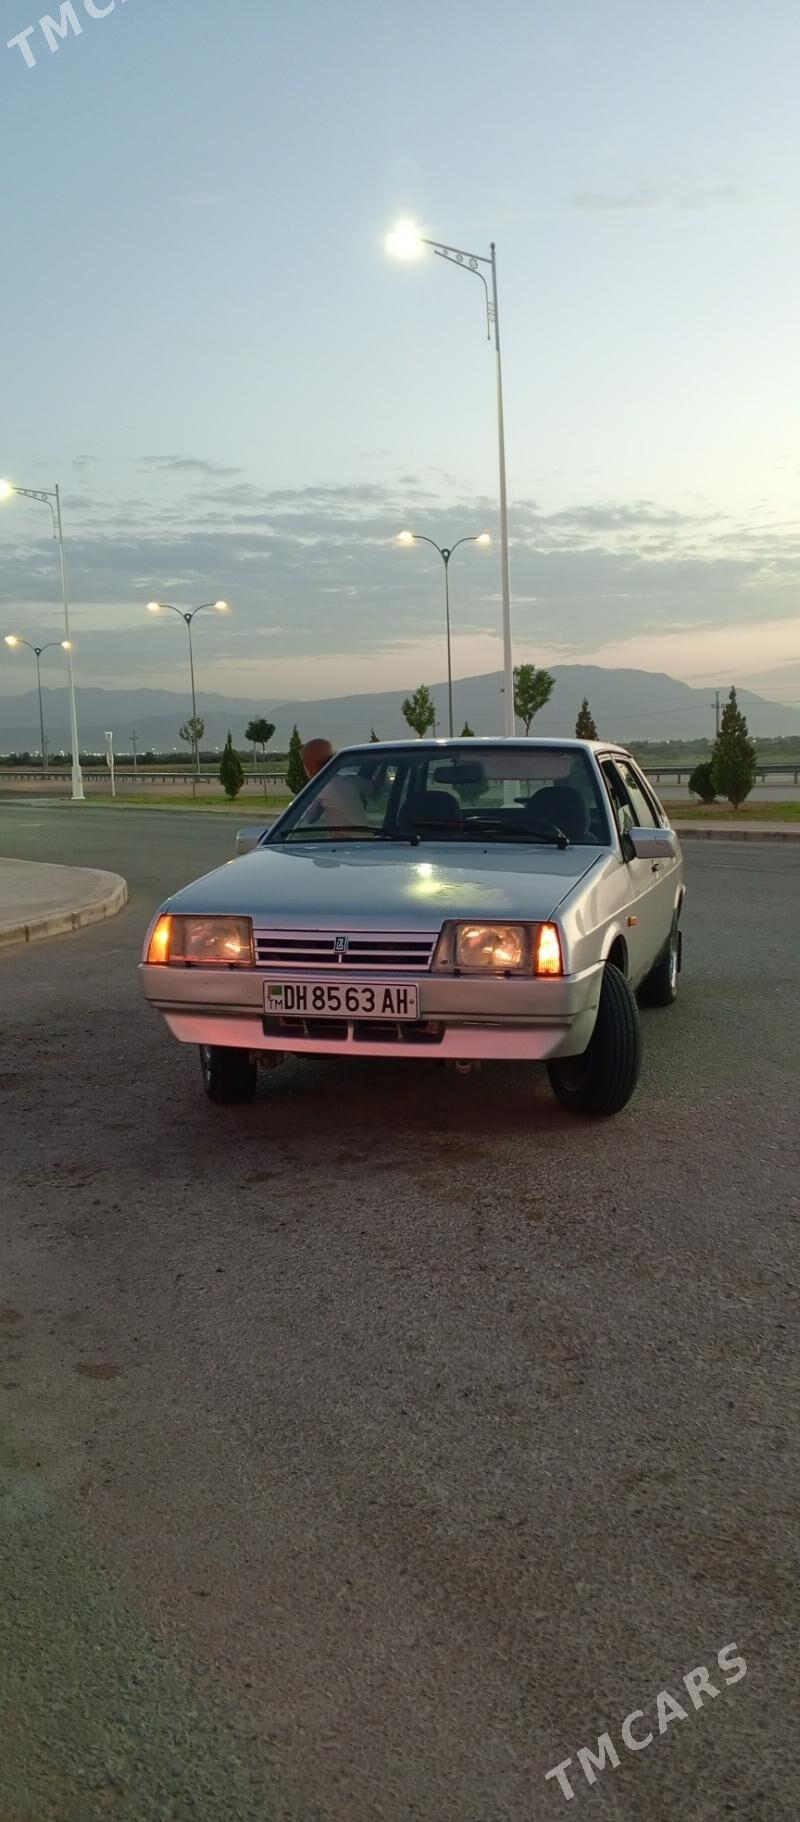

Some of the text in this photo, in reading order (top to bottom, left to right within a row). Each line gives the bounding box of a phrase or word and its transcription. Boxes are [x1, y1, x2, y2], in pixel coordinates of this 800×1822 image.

[269, 999, 283, 1010] TM
[284, 985, 307, 1011] DH
[381, 988, 408, 1015] AH
